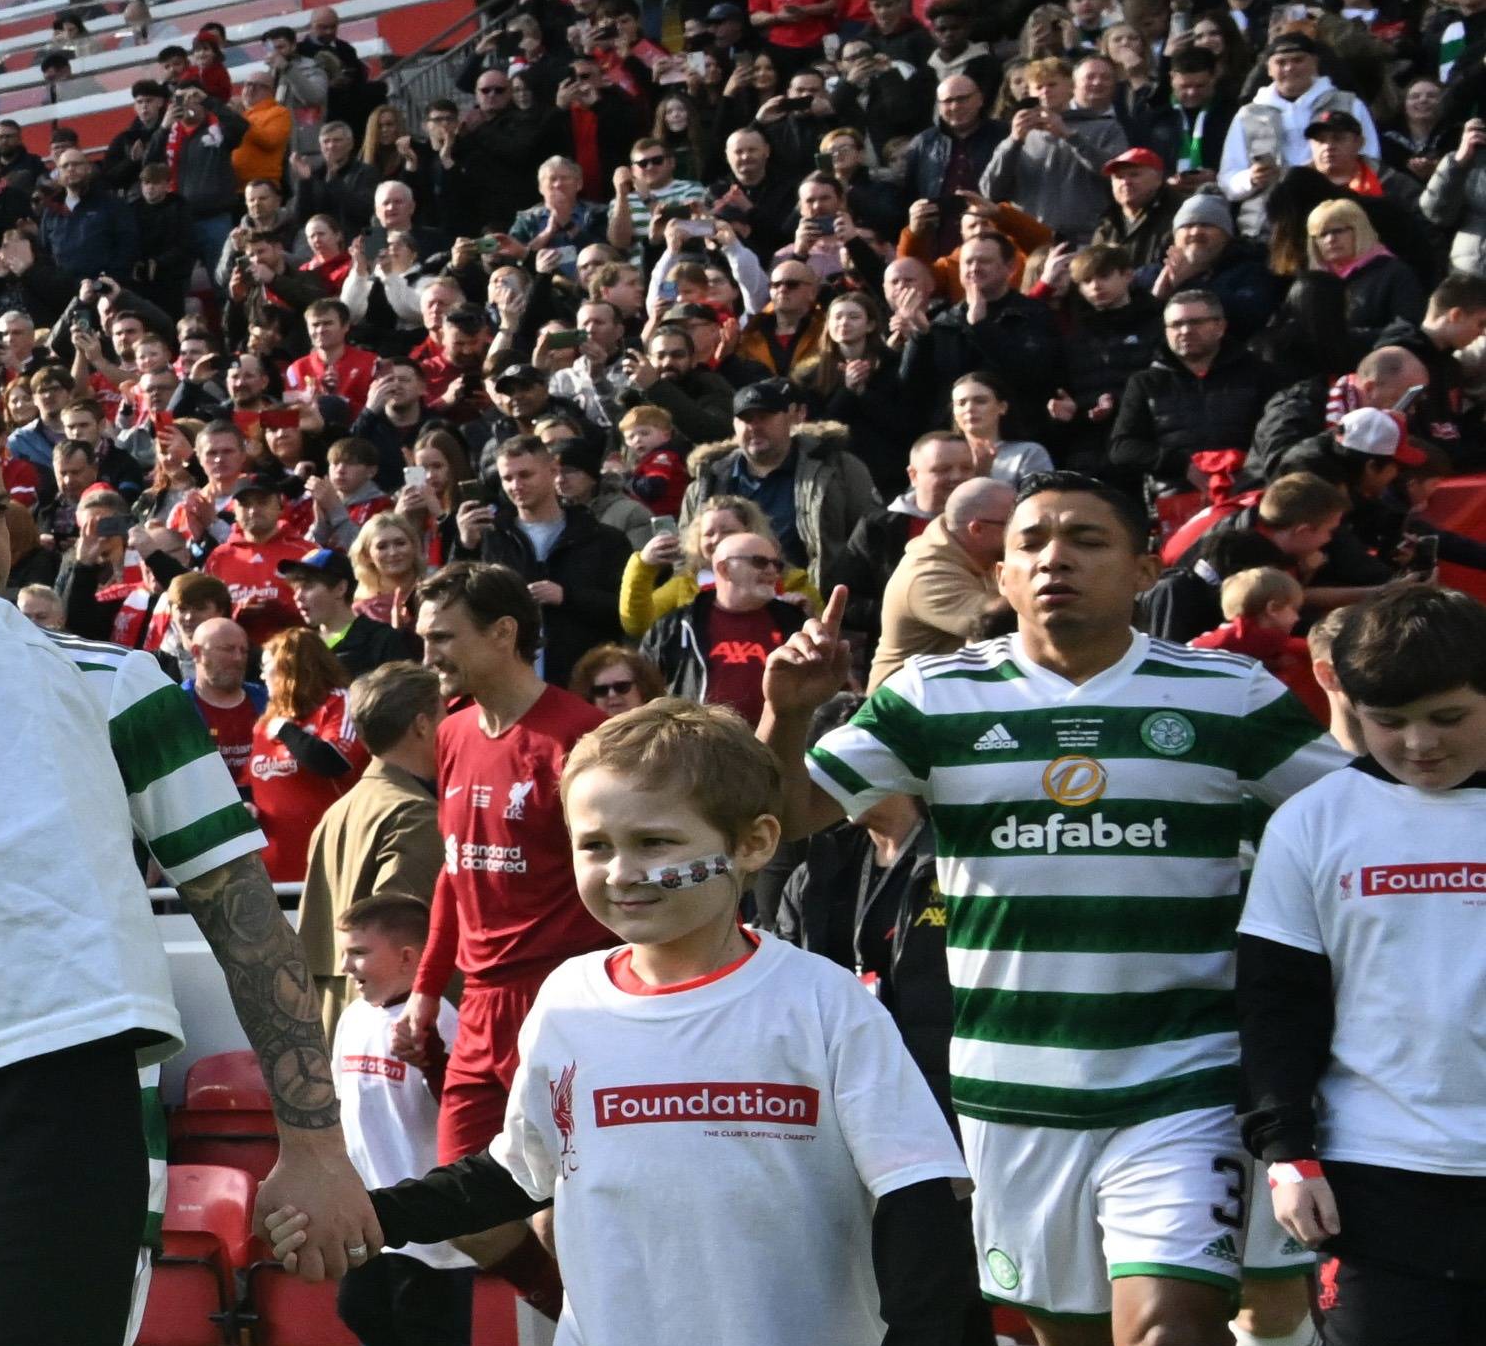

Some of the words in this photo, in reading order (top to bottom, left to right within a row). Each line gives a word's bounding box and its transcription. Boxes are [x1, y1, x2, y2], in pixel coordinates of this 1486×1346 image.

[709, 640, 767, 664] AXA
[973, 739, 1019, 751] adidas
[992, 812, 1168, 854] dafabet
[913, 906, 947, 927] AX
[602, 1088, 806, 1120] Foundation
[704, 1130, 719, 1138] THE
